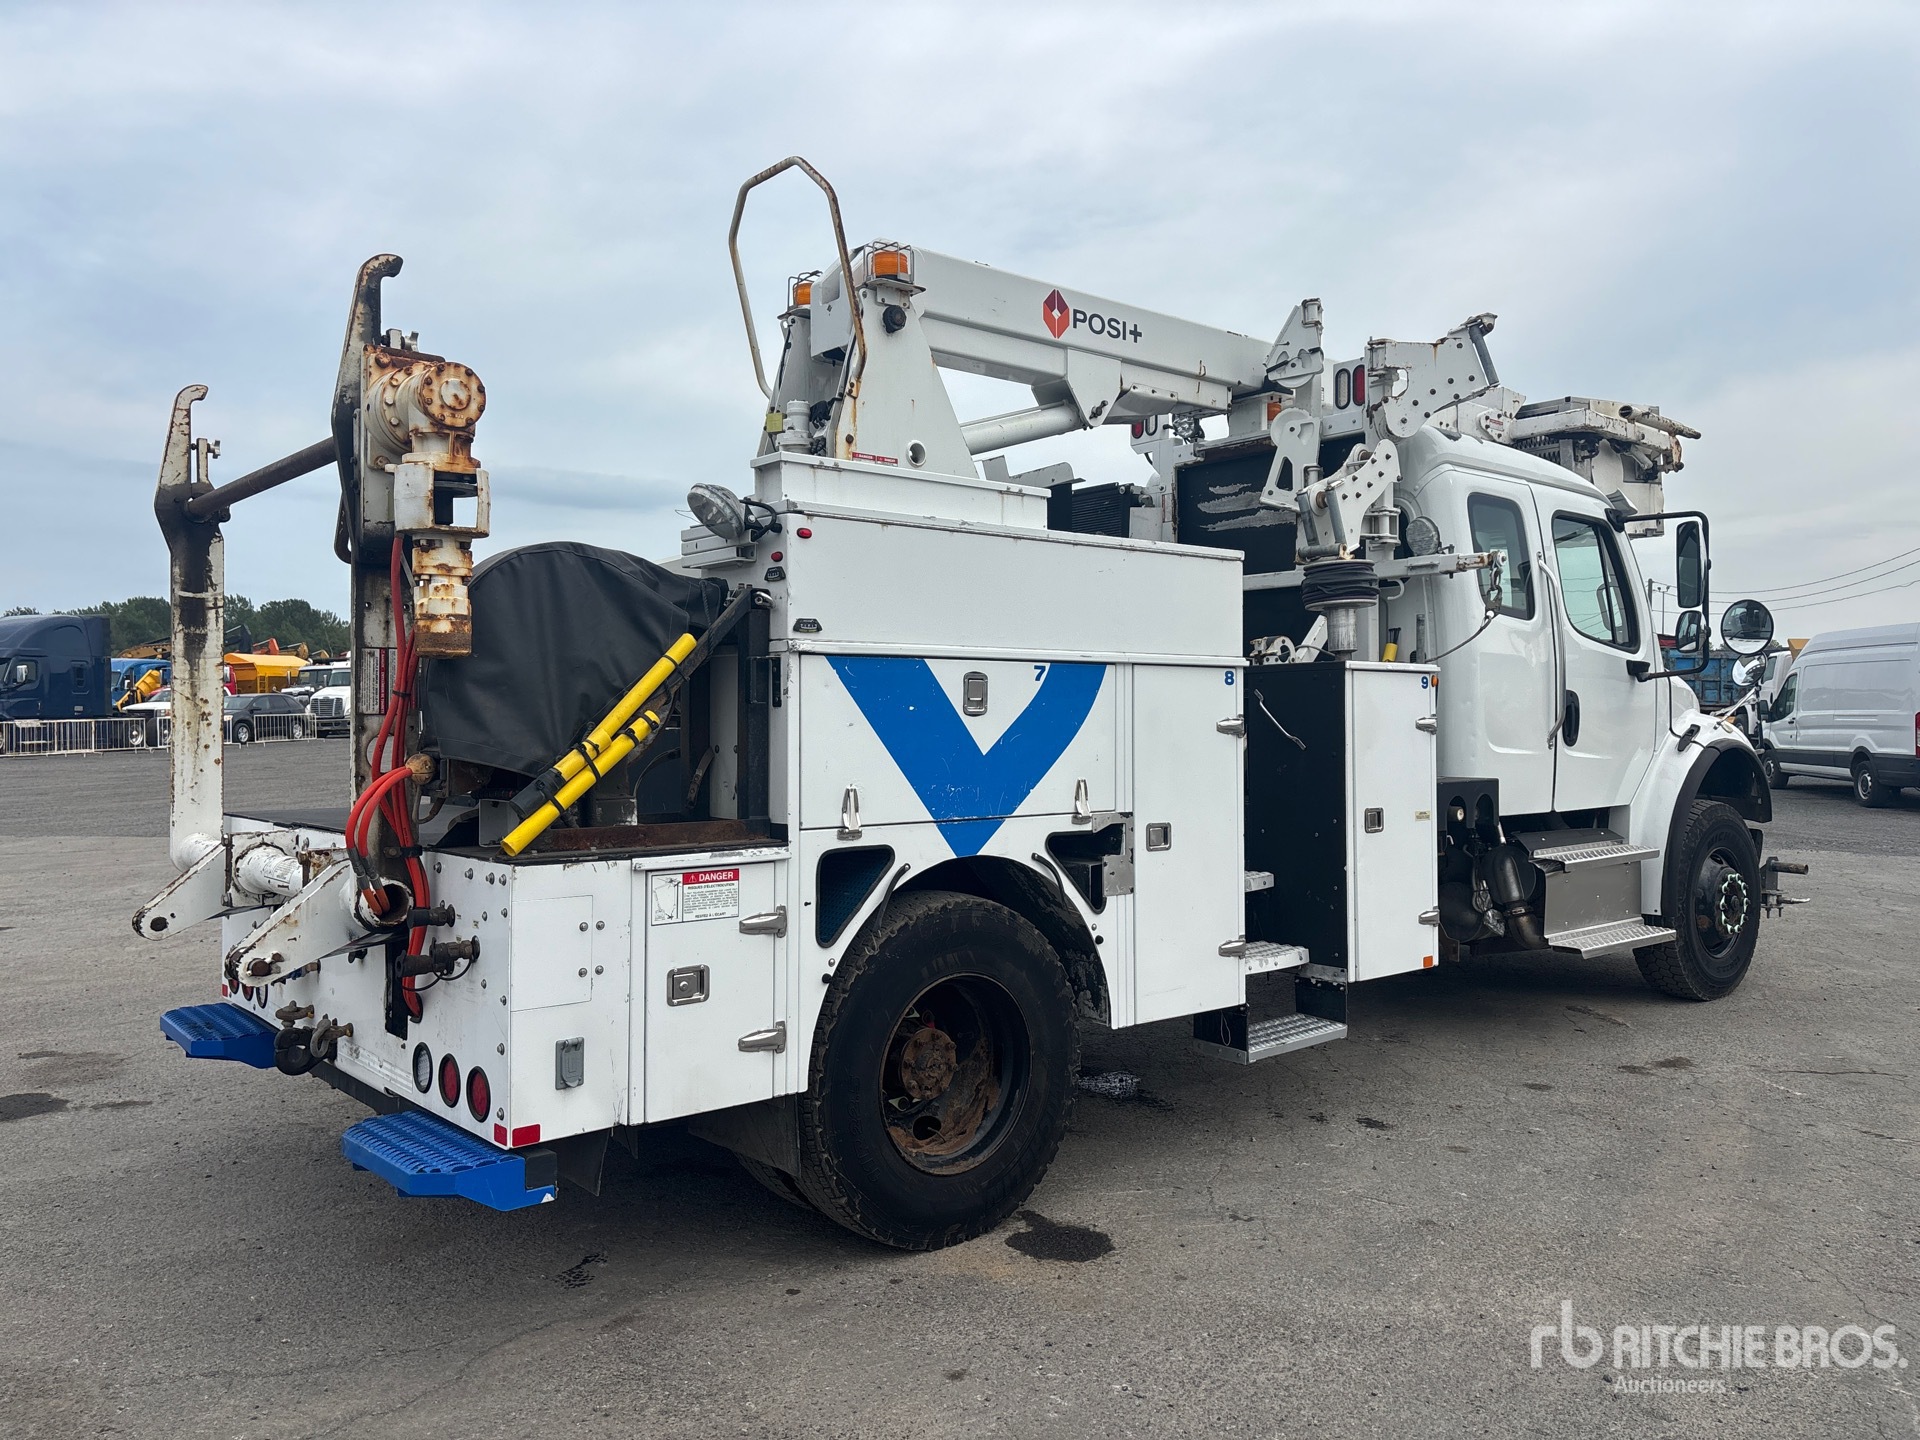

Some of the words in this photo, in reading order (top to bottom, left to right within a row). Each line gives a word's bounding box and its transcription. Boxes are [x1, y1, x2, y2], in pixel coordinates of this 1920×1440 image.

[1072, 308, 1143, 344] POSI+
[1033, 665, 1046, 682] 7
[1224, 670, 1235, 686] 8
[1421, 675, 1429, 690] 9
[698, 871, 734, 881] DANGER
